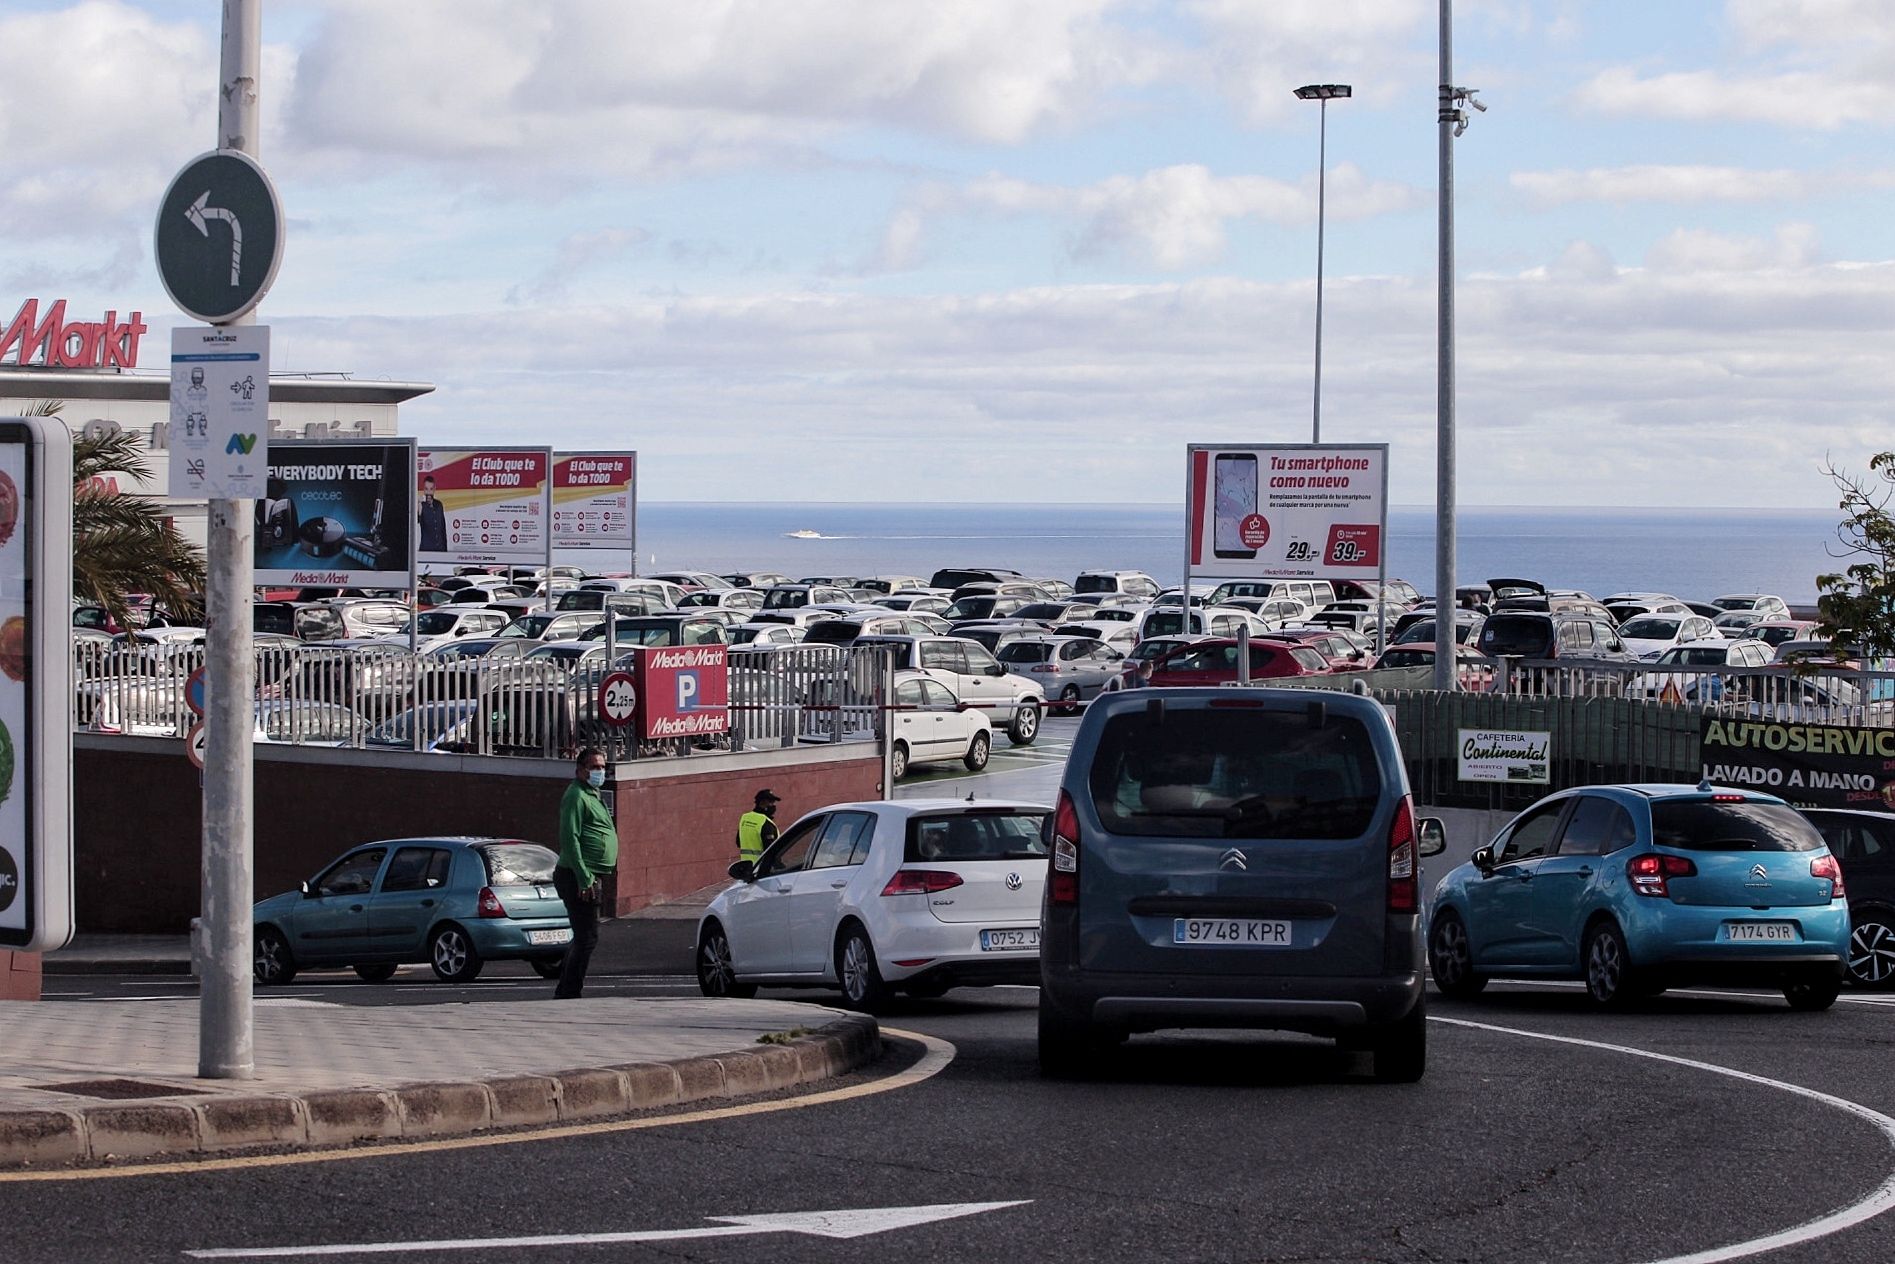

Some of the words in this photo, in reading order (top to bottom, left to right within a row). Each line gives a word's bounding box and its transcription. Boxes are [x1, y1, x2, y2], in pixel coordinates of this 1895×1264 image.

[0, 299, 147, 367] Markt
[267, 465, 345, 480] EVERYBODY
[347, 464, 383, 480] TECH
[472, 458, 481, 470] El
[482, 458, 503, 470] Club
[504, 460, 523, 472] que
[524, 459, 535, 470] te
[570, 461, 578, 471] El
[578, 460, 596, 471] Club
[597, 462, 613, 472] que
[614, 461, 623, 471] te
[1271, 457, 1286, 470] Tu
[1287, 456, 1369, 473] smartphone
[470, 473, 480, 485] lo
[481, 473, 494, 485] da
[495, 473, 520, 485] TODO
[568, 473, 577, 484] lo
[578, 473, 588, 484] da
[589, 473, 611, 484] TODO
[1270, 476, 1306, 488] como
[1307, 476, 1349, 488] nuevo
[301, 491, 343, 501] cecotec
[678, 674, 696, 708] P
[1463, 738, 1548, 761] Continental
[1702, 764, 1783, 786] LAVADO
[1788, 769, 1805, 787] A
[1810, 771, 1876, 792] MANO
[991, 932, 1024, 945] 0752
[1189, 922, 1240, 940] 9748
[1247, 923, 1286, 941] KPR
[1731, 925, 1763, 939] 7174
[1767, 924, 1791, 939] GYR
